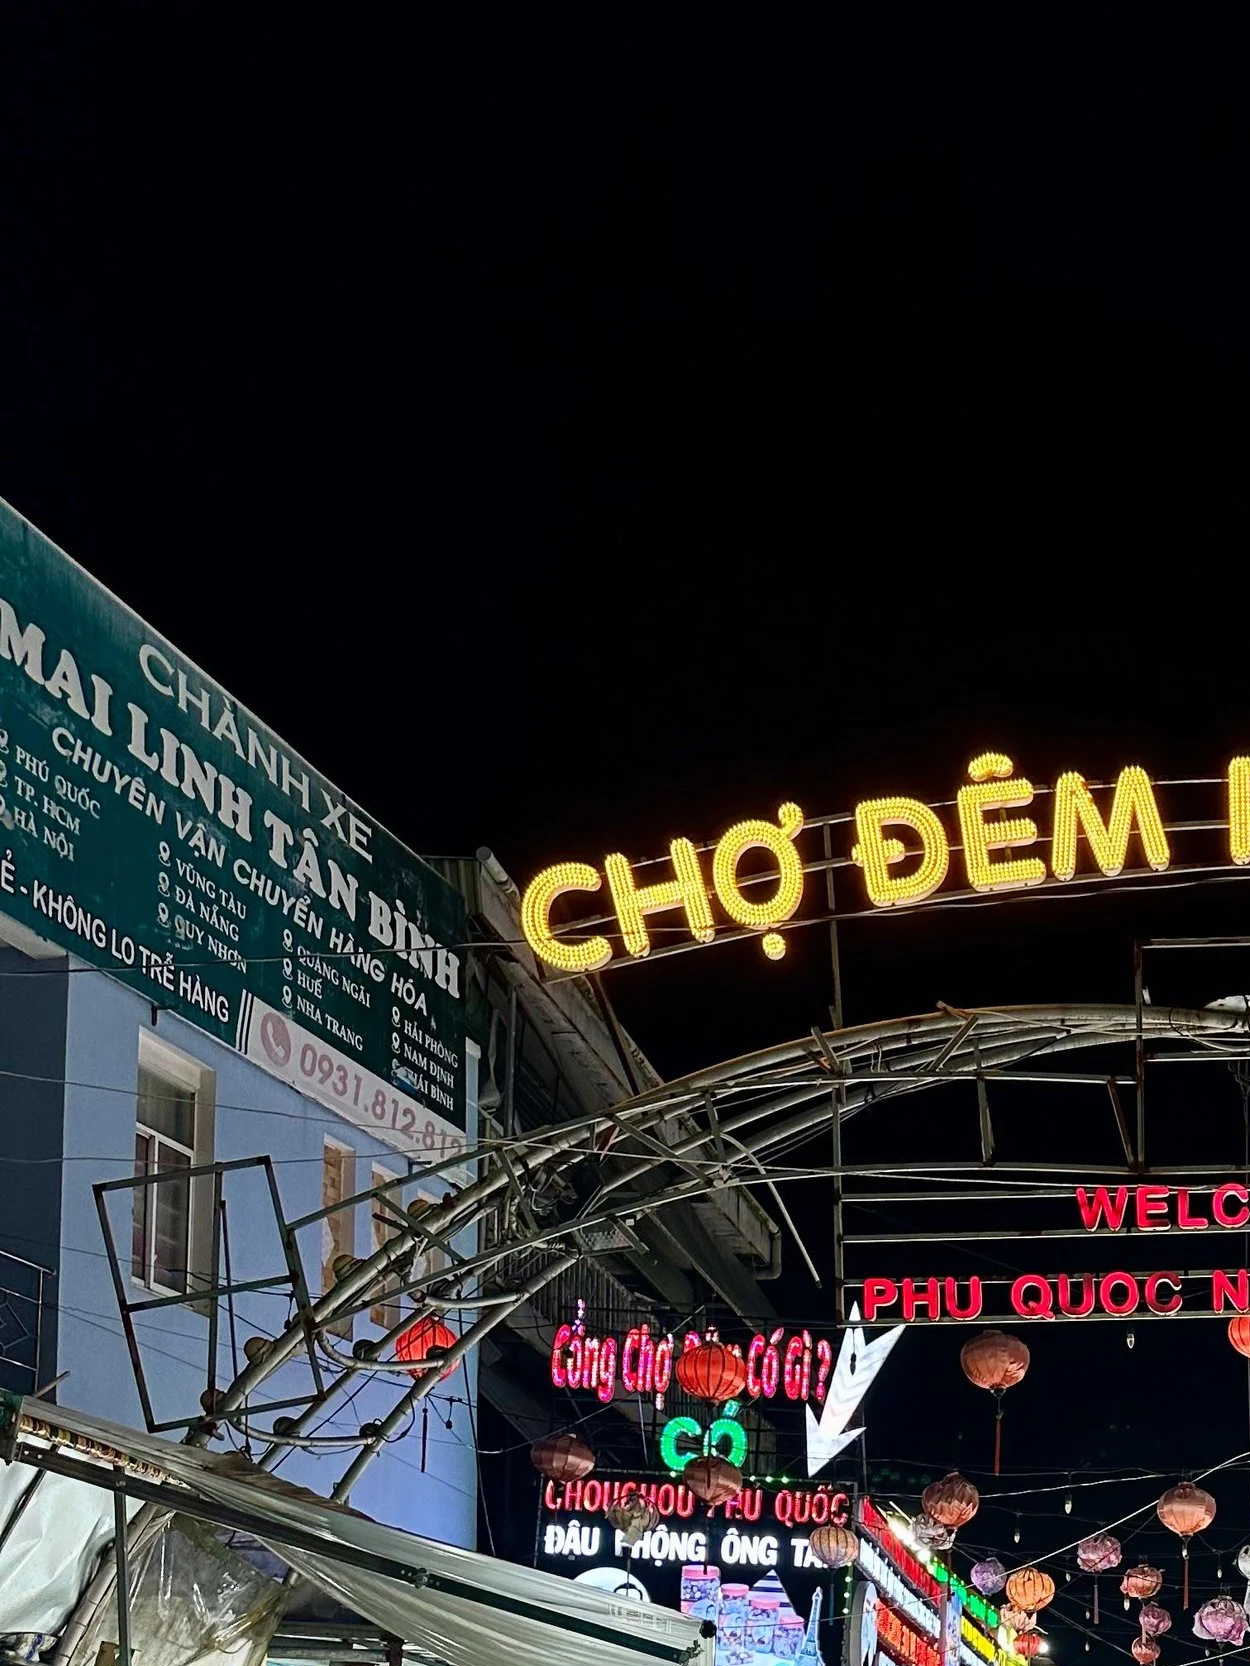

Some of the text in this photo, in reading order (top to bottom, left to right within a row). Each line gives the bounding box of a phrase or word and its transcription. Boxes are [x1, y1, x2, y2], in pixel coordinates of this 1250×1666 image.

[139, 643, 373, 864] CHÀNH XE
[0, 598, 460, 999] MAI LINH TÂN BÌNH
[16, 746, 100, 819] PHÚ QUỐC
[14, 806, 75, 862] HÀ NỘI
[43, 795, 81, 836] HCM
[52, 726, 427, 1017] CHUYÊN VẬN CHUYỂN HÀNG HÓA
[175, 858, 247, 920] VŨNG TÀU
[521, 802, 806, 978] CHỢ
[851, 752, 1173, 909] ĐÊM
[175, 884, 196, 914] ĐÀ
[33, 880, 107, 949] KHÔNG
[112, 929, 135, 965] LO
[139, 945, 176, 991] TRỄ
[179, 969, 229, 1023] HÀNG
[174, 915, 247, 974] QUY NHƠN
[297, 970, 323, 999] HUẾ
[297, 994, 364, 1051] NHA TRANG
[404, 1019, 459, 1068] HẢI PHÒNG
[404, 1043, 455, 1088] NAM ĐỊNH
[431, 1084, 454, 1111] BÌNH
[862, 1276, 983, 1322] PHU
[1010, 1271, 1182, 1320] QUOC
[775, 1484, 848, 1528] QUỐC
[544, 1520, 600, 1560] ĐẬU
[721, 1527, 779, 1566] ÔNG
